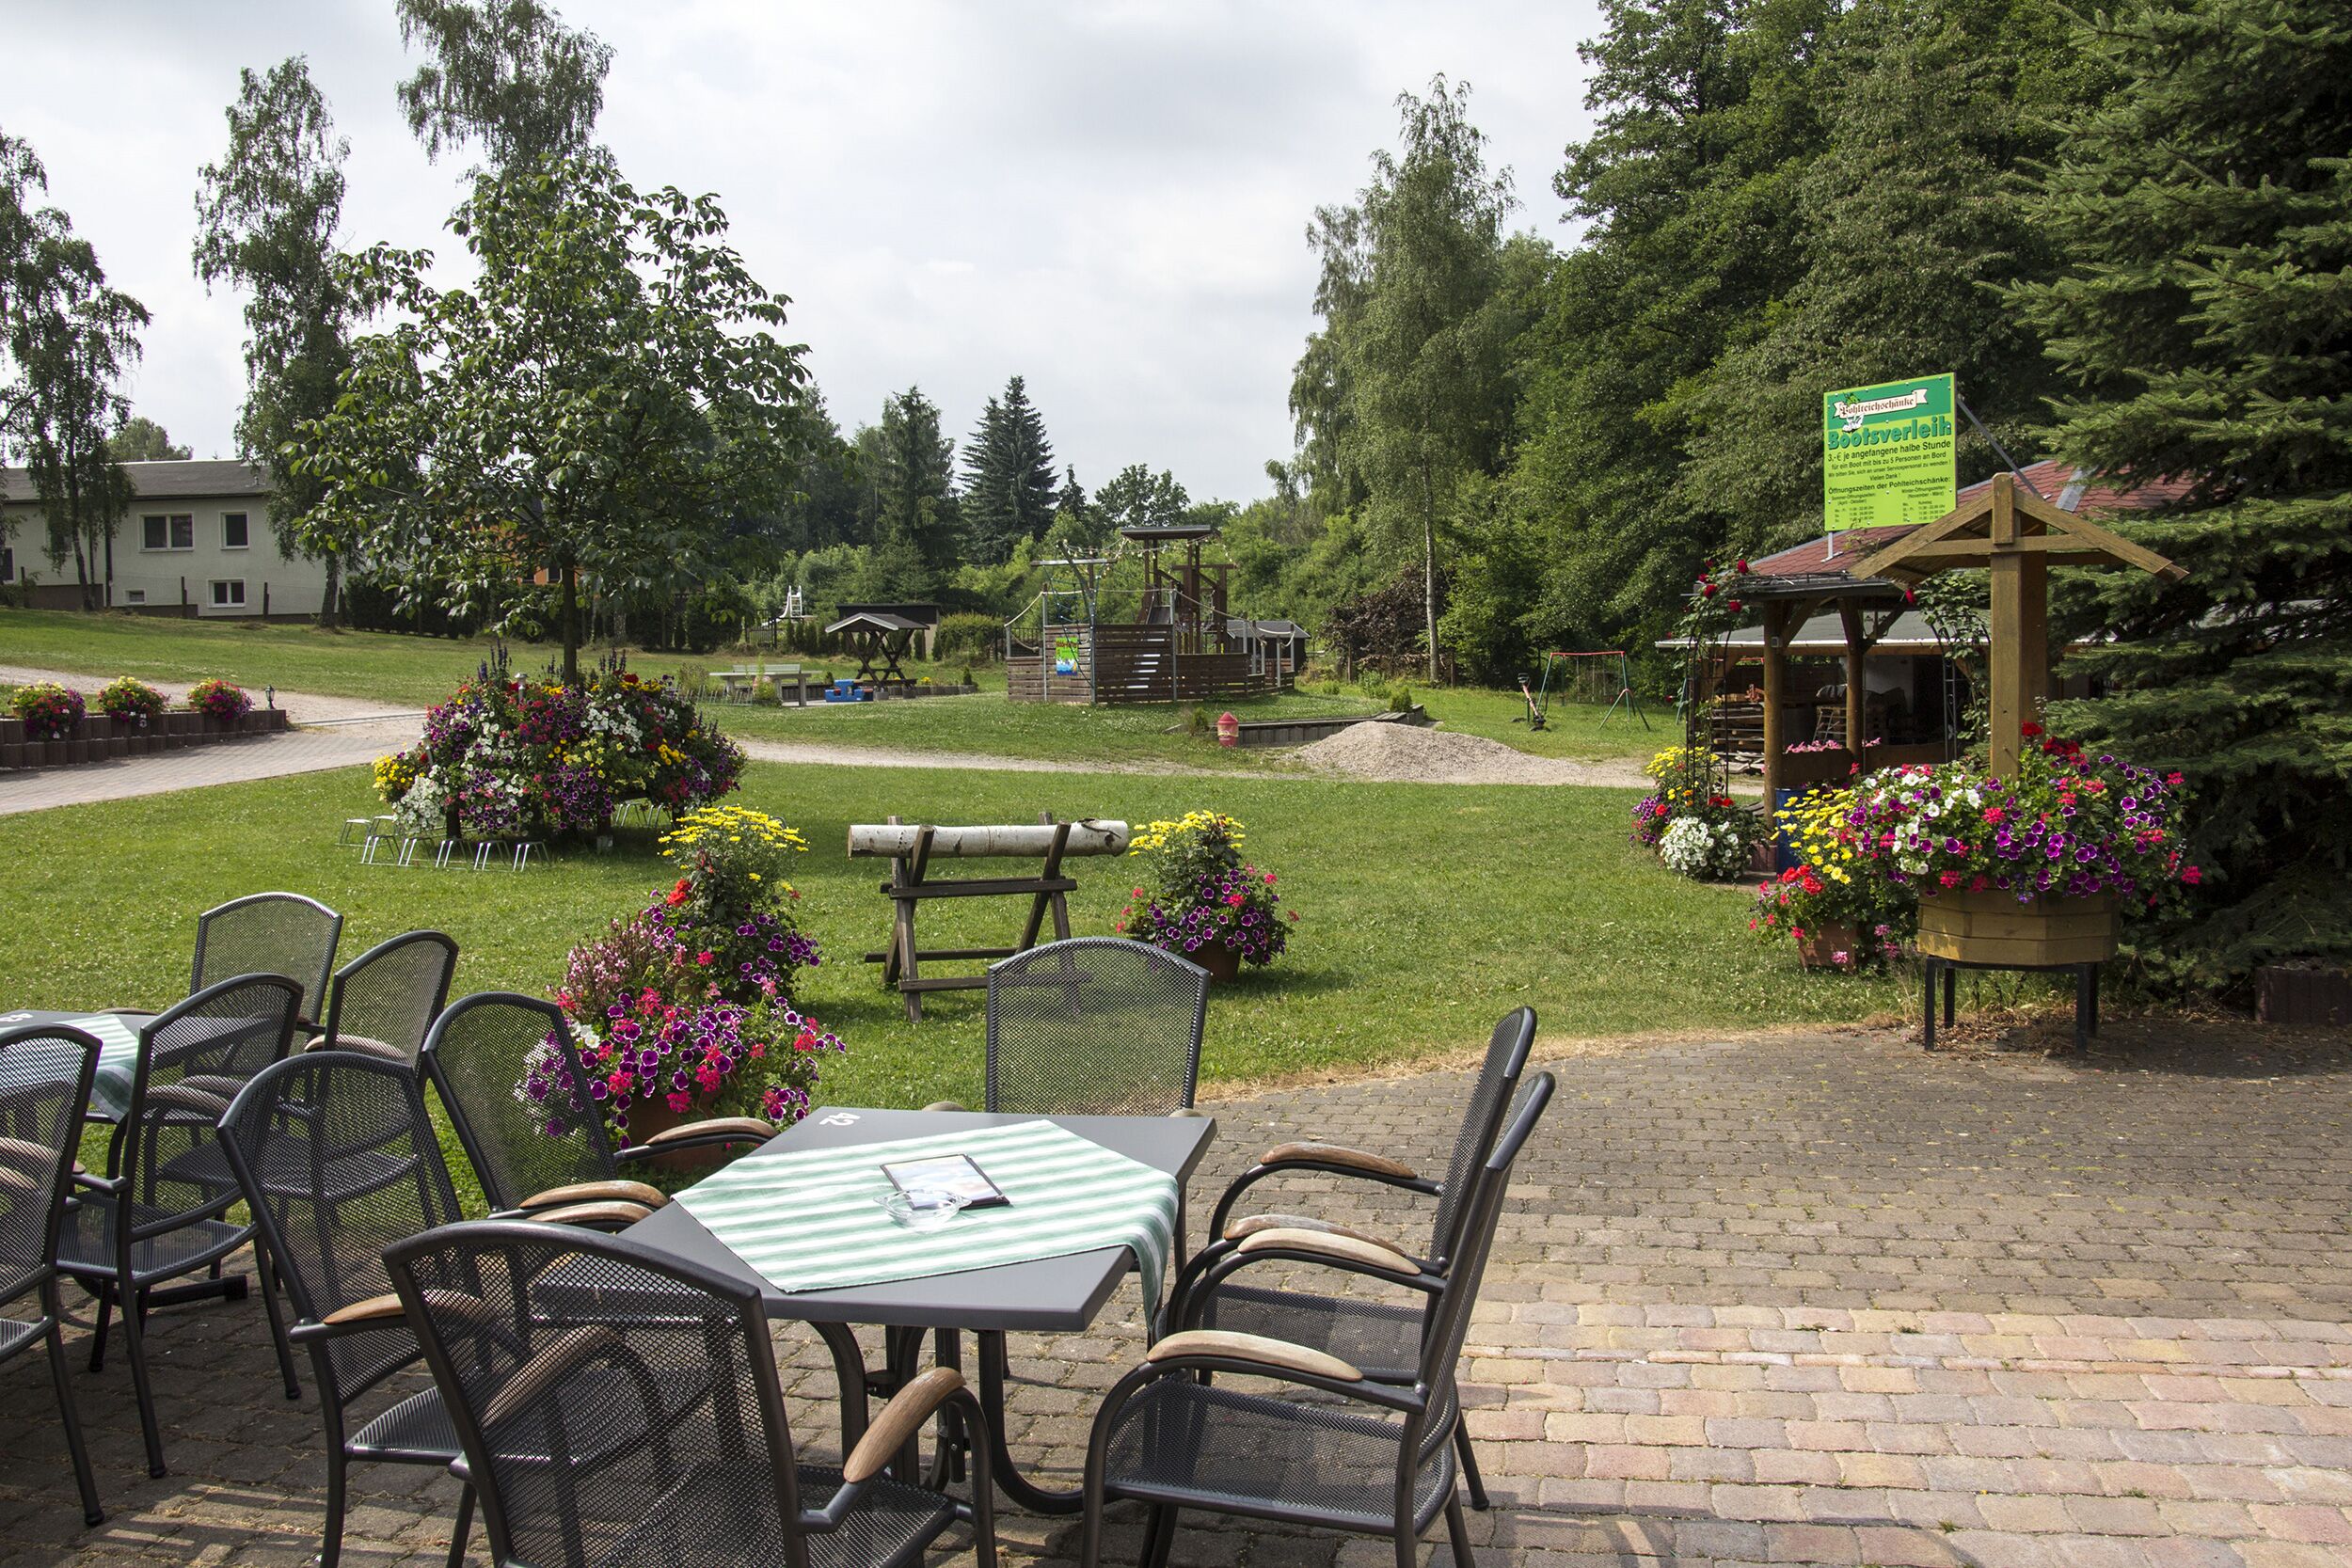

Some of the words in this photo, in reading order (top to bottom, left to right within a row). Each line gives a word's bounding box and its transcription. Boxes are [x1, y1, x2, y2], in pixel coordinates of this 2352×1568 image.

[1828, 415, 1952, 450] Bootsverleih
[1843, 451, 1850, 462] je
[1851, 447, 1899, 459] angefangene
[1899, 442, 1921, 453] halbe
[1923, 439, 1951, 451] Stunde
[1849, 460, 1862, 468] Boot
[1895, 453, 1922, 464] Personen
[1931, 451, 1947, 459] Bord
[1869, 473, 1885, 482] Vielen
[1828, 483, 1875, 495] Öffnungszeiten
[1876, 482, 1887, 490] der
[818, 1112, 861, 1126] 42
